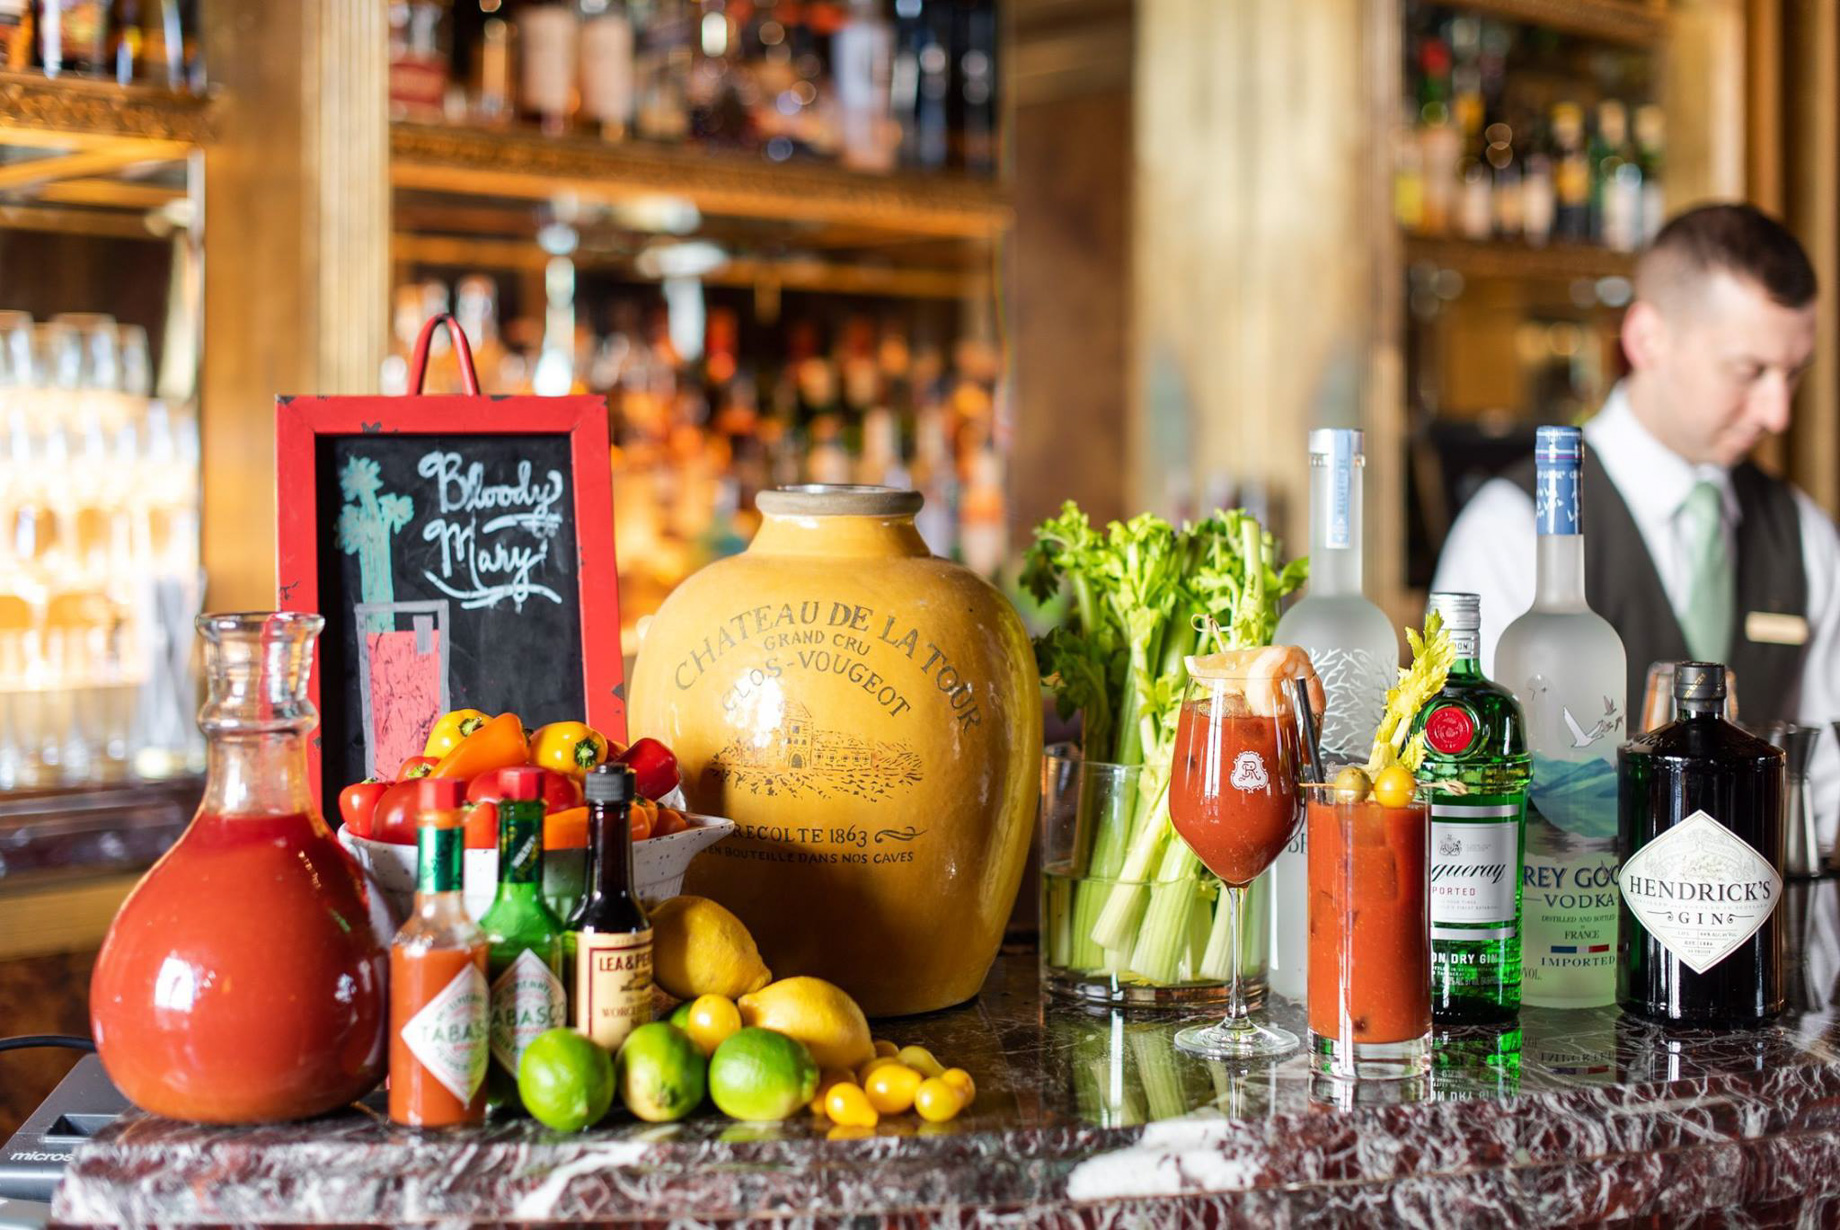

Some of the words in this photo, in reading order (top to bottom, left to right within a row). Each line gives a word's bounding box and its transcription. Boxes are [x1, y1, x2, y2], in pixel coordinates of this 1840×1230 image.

[418, 451, 563, 515] Bloody
[423, 519, 549, 600] Mary
[763, 629, 825, 652] GRAND
[832, 633, 871, 656] CRU
[674, 600, 821, 691] CHATEAU
[827, 602, 874, 632] DE
[878, 615, 920, 659] LA
[921, 640, 983, 734] TOUR
[722, 650, 911, 718] CLOS-VOUGEOT
[732, 823, 824, 844] RECOLTE
[830, 823, 868, 848] 1863
[725, 846, 795, 863] BOUTEILLE
[799, 852, 838, 864] DANS
[841, 853, 868, 864] NOS
[873, 851, 914, 864] CAVES
[1629, 875, 1771, 902] HENDRICK'S
[1543, 893, 1615, 909] VODKA
[1678, 913, 1723, 925] GIN
[1564, 930, 1600, 940] FRANCE
[1450, 953, 1476, 965] DRY
[1541, 955, 1616, 968] IMPORTED
[10, 1151, 75, 1162] micros
